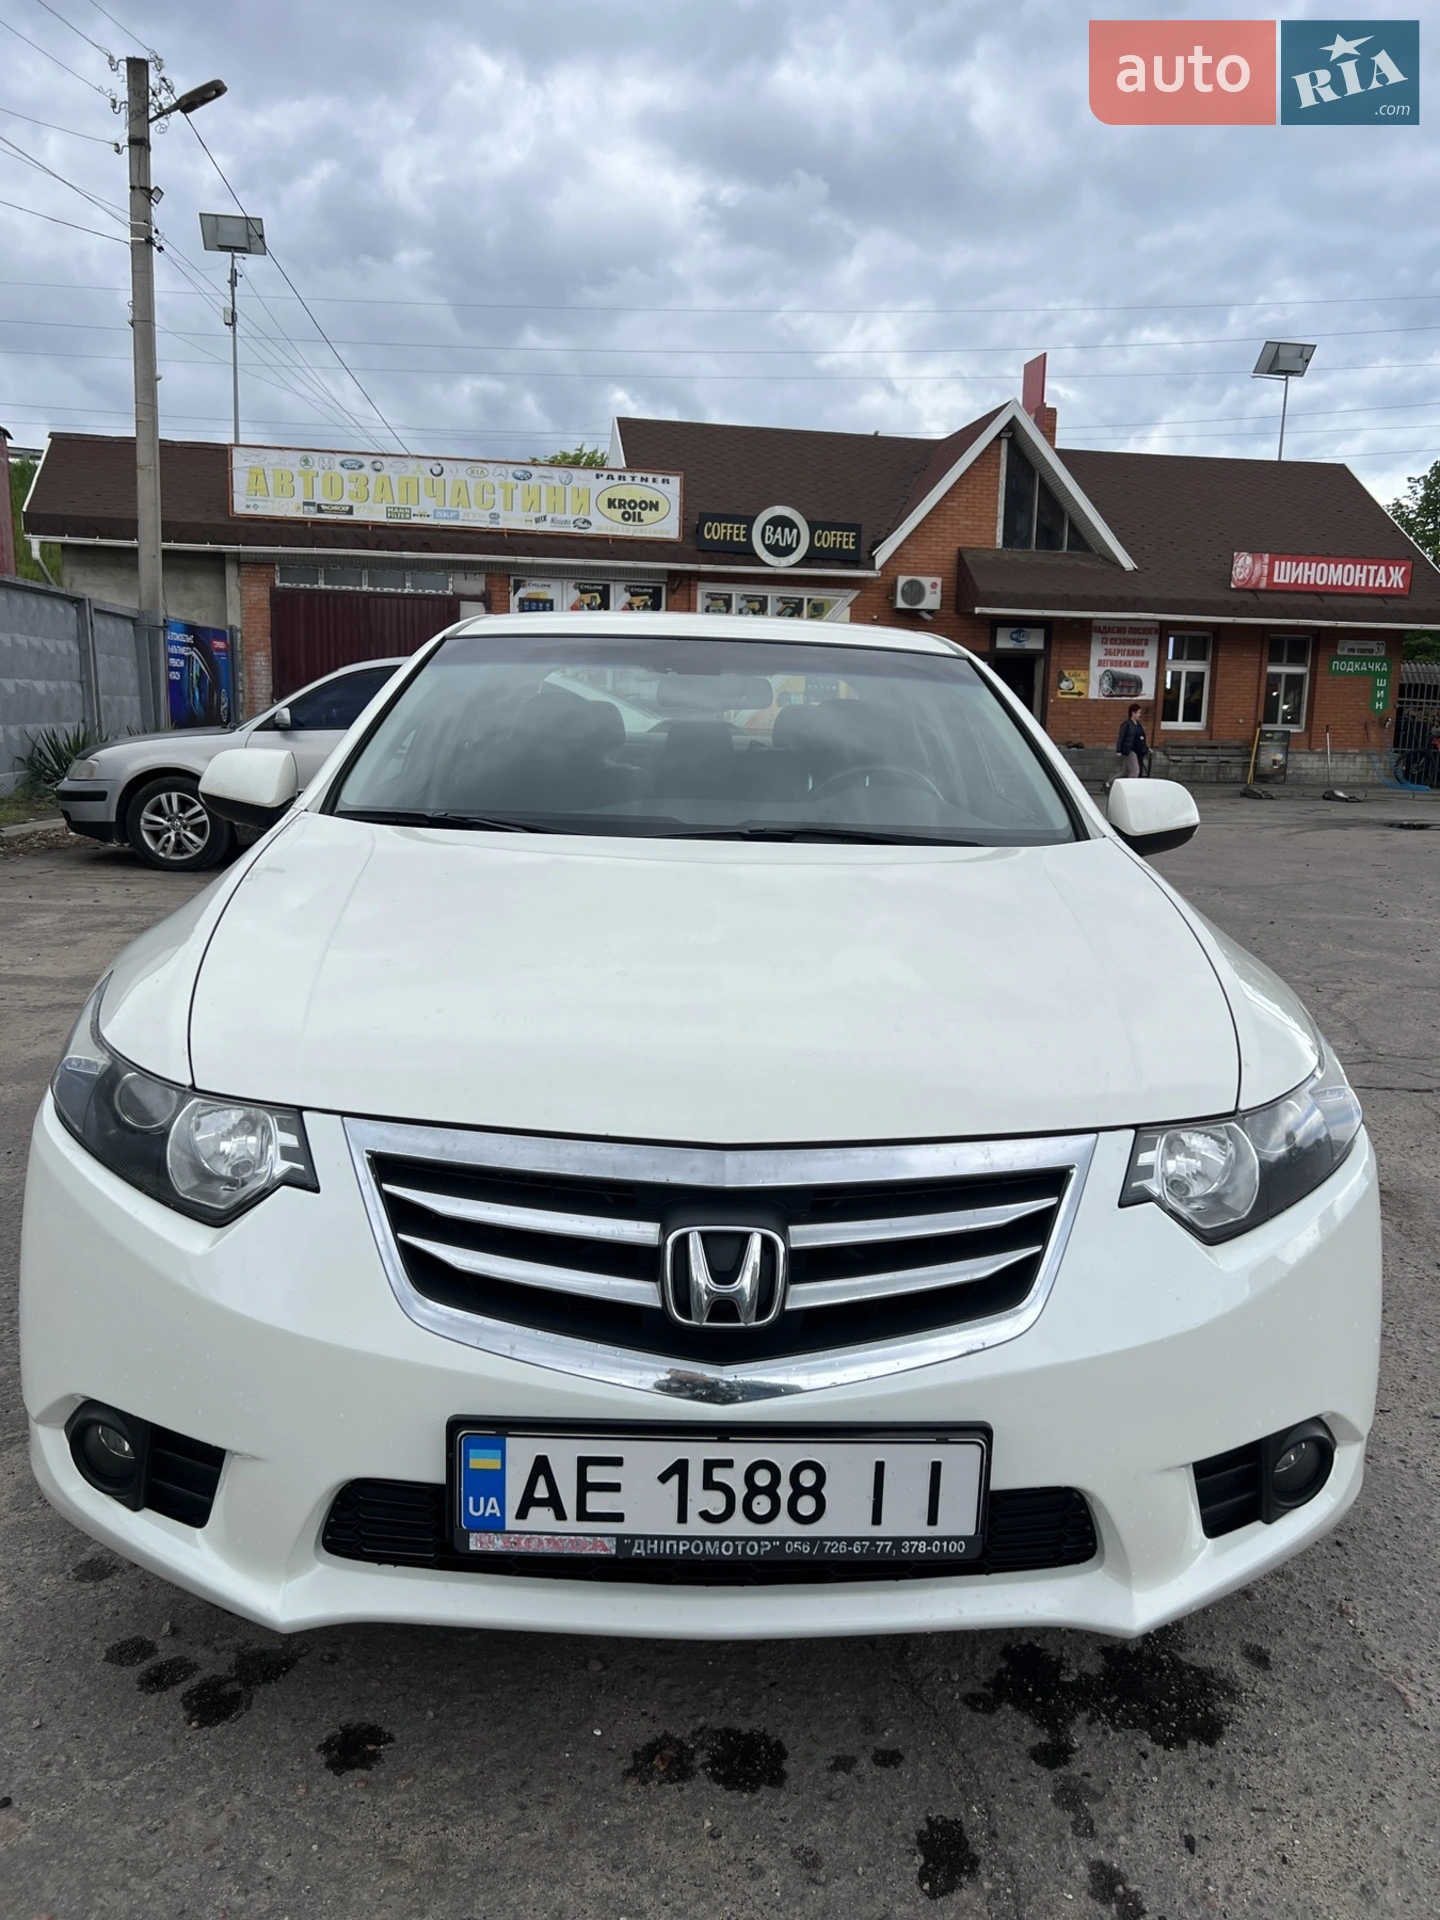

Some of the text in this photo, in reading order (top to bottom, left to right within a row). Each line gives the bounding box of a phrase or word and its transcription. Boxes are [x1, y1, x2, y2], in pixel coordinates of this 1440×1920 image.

[595, 473, 671, 485] PARTNER
[246, 466, 591, 517] АВТОЗАПЧАСТИНИ
[607, 497, 659, 512] KROON
[534, 514, 548, 525] WIX
[621, 510, 644, 523] OIL
[704, 521, 747, 542] COFFEE
[814, 529, 856, 550] COFFEE
[1273, 560, 1406, 589] ШИНОМОНТАЖ
[1110, 638, 1149, 646] СЕЗОННОГО
[1375, 642, 1385, 654] 37
[1104, 648, 1145, 657] ЗБЕРІГАННЯ
[1133, 660, 1149, 668] ШИН
[1332, 661, 1388, 673] ПОДКАЧКА
[515, 1454, 625, 1521] AE
[656, 1458, 828, 1525] 1588
[468, 1496, 501, 1518] UA
[502, 1535, 610, 1553] HONDA
[624, 1539, 780, 1556] "ДНІПРОМОТОР"
[785, 1541, 811, 1554] 056
[901, 1540, 965, 1553] 378-0100
